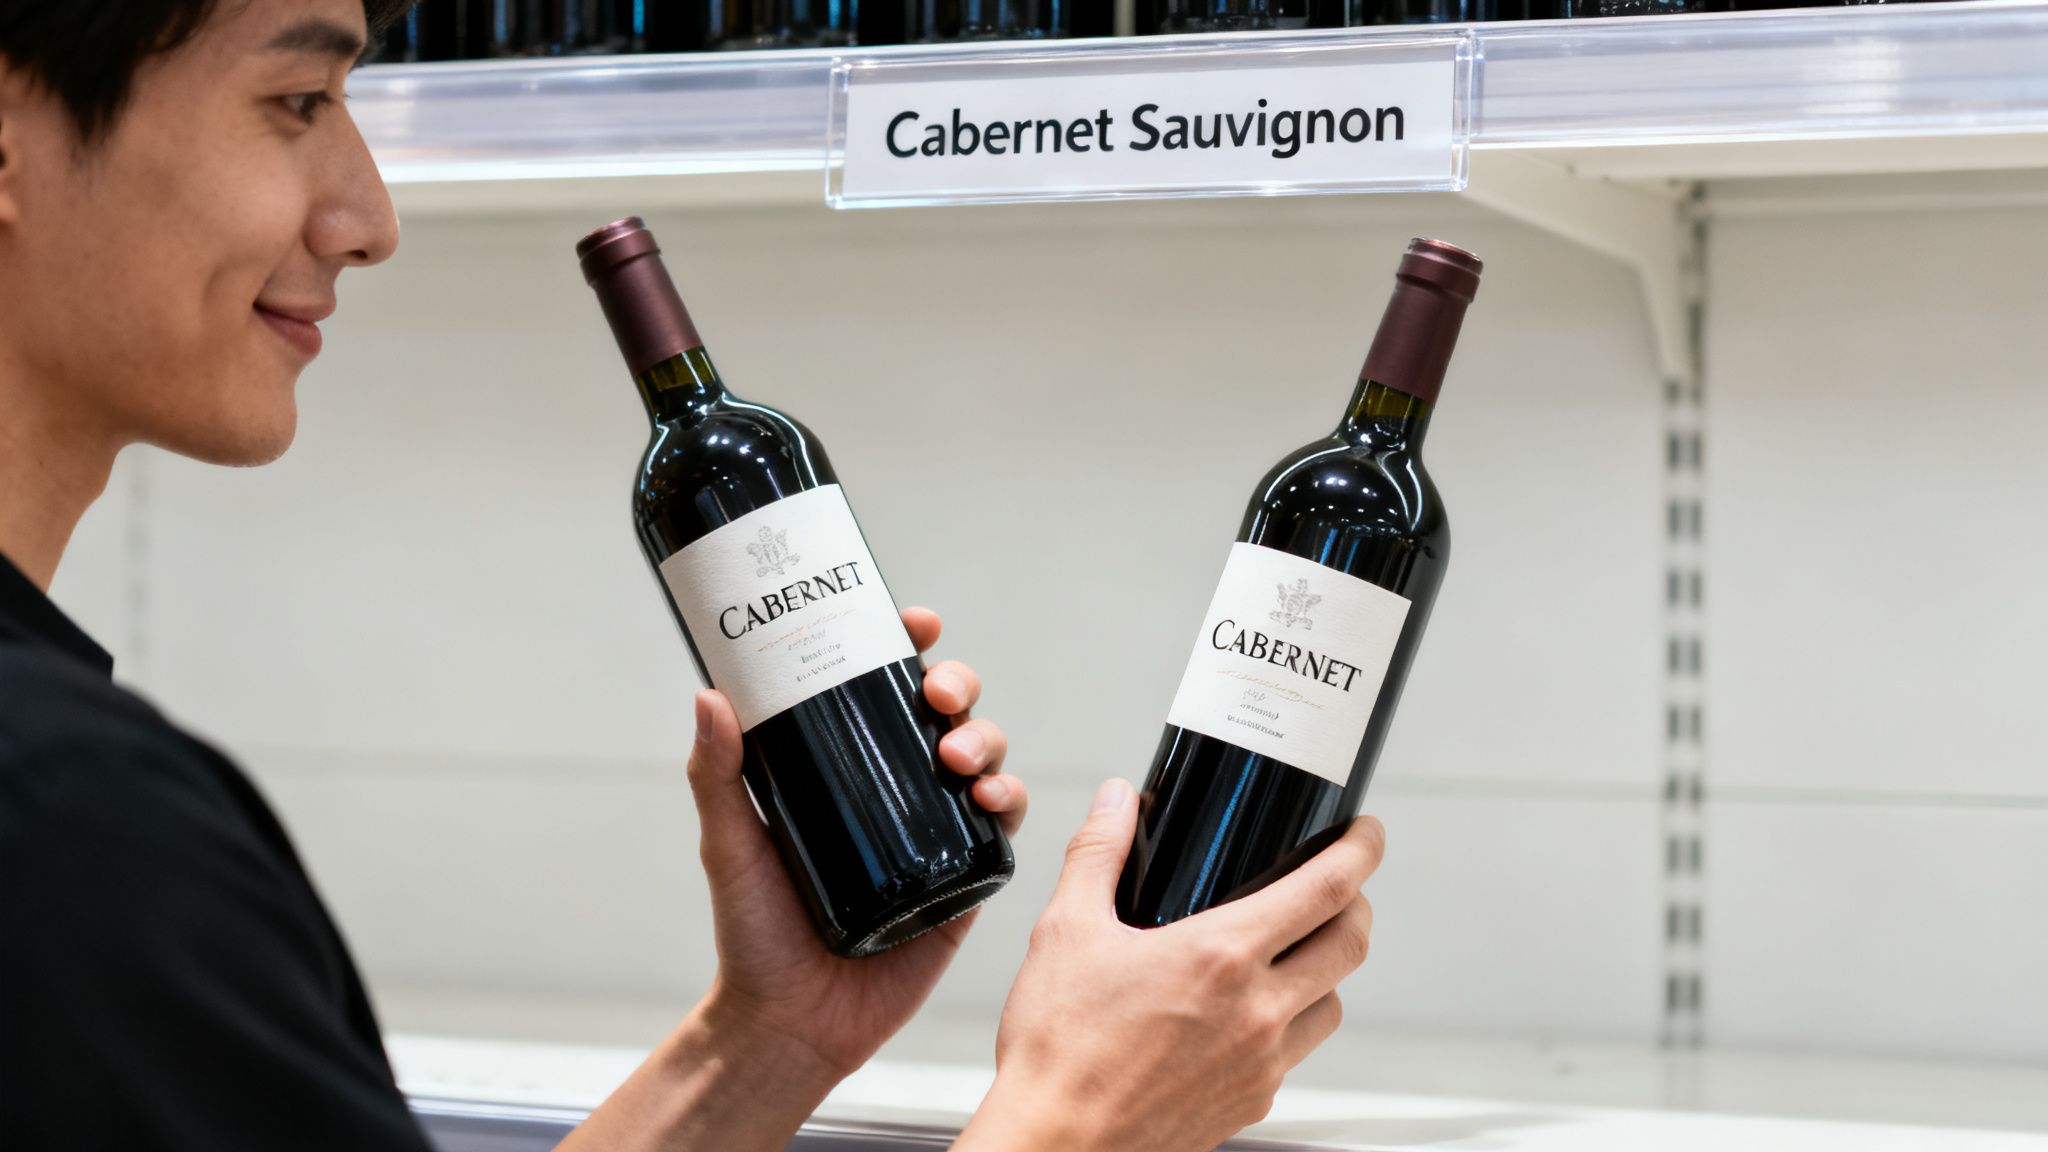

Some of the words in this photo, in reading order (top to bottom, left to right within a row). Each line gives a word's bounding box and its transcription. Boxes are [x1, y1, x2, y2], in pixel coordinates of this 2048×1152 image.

[885, 107, 1114, 159] Cabernet
[1129, 98, 1405, 160] Sauvignon
[719, 561, 865, 640] CABERNET
[1212, 619, 1363, 692] CABERNET
